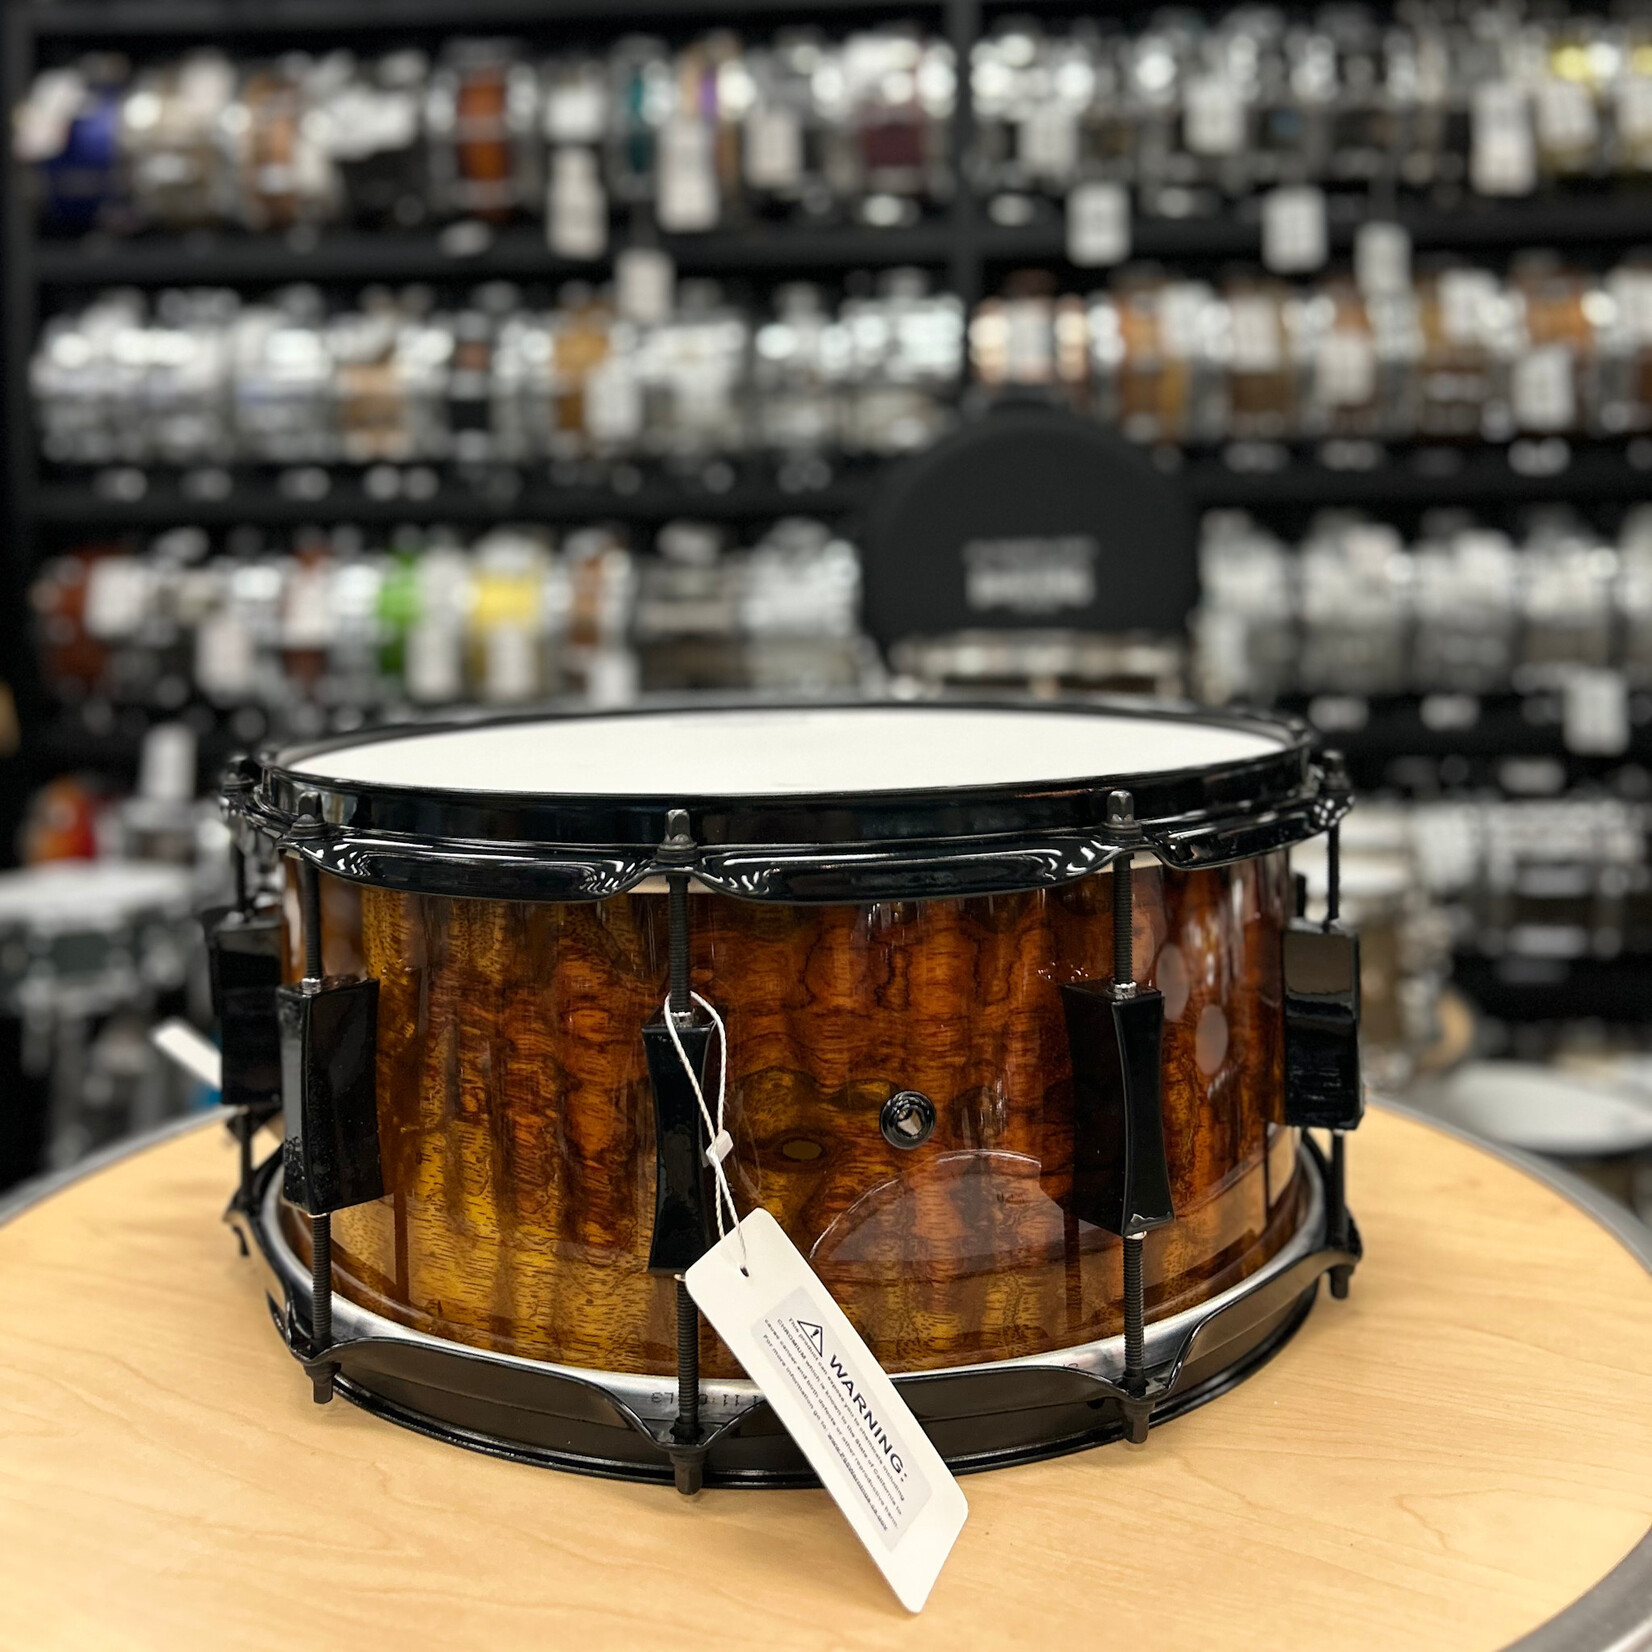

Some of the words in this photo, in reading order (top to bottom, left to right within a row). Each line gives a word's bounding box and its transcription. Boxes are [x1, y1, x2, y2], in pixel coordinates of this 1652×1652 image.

[762, 1333, 773, 1347] For
[771, 1347, 786, 1366] more
[785, 1366, 814, 1409] information
[764, 1318, 780, 1339] cause
[779, 1340, 797, 1364] cancer
[796, 1365, 807, 1379] and
[805, 1379, 818, 1398] birth
[817, 1398, 836, 1426] defects
[841, 1436, 855, 1456] other
[854, 1457, 885, 1506] reproductive
[776, 1318, 806, 1359] CHROMIUM
[804, 1360, 820, 1382] which
[824, 1389, 841, 1415] known
[846, 1424, 855, 1438] the
[854, 1438, 868, 1458] State
[872, 1467, 896, 1506] California
[788, 1317, 799, 1333] This
[797, 1333, 819, 1361] product
[817, 1361, 827, 1375] can
[826, 1375, 844, 1402] expose
[843, 1402, 854, 1417] you
[858, 1426, 883, 1465] chemicals
[882, 1464, 905, 1501] including
[829, 1354, 907, 1482] WARNING:
